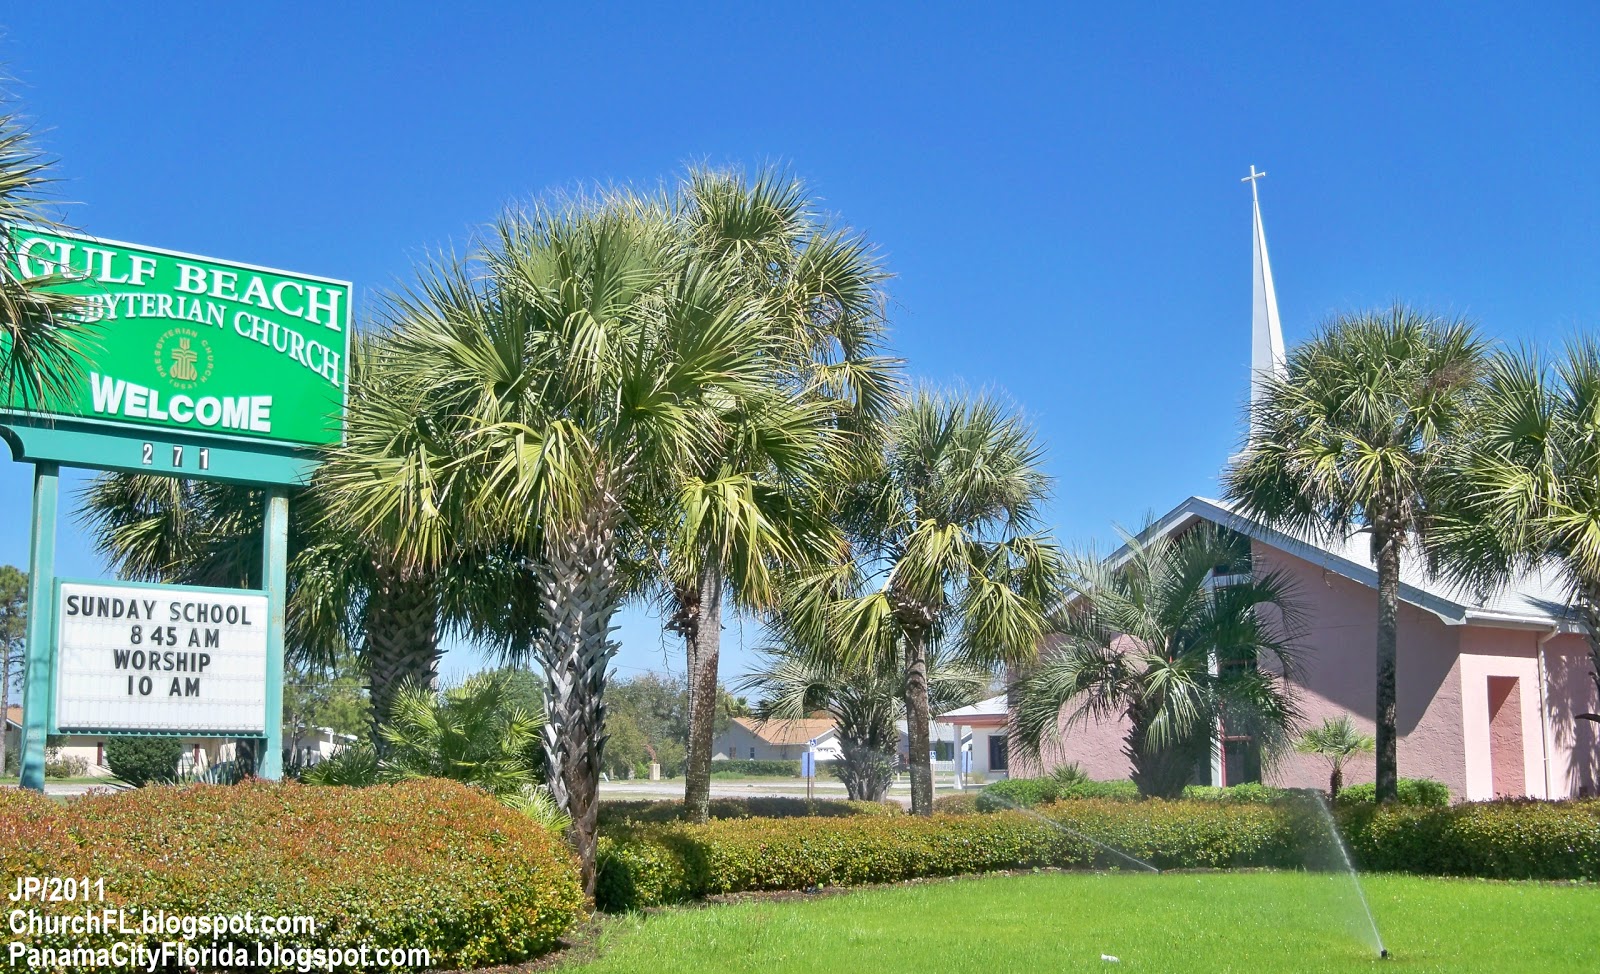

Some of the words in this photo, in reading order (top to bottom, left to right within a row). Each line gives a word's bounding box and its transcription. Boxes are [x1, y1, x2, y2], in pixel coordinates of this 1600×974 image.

[17, 237, 158, 286] GULF
[174, 262, 343, 332] BEACH
[154, 327, 198, 378] PRESBYTERIAN
[201, 339, 214, 383] CHURCH
[234, 311, 341, 388] CHURCH
[90, 371, 273, 433] WELCOME
[66, 594, 157, 620] SUNDAY
[169, 601, 252, 626] SCHOOL
[187, 628, 220, 648] AM
[113, 648, 211, 673] WORSHIP
[127, 675, 153, 696] 10
[169, 677, 200, 697] AM
